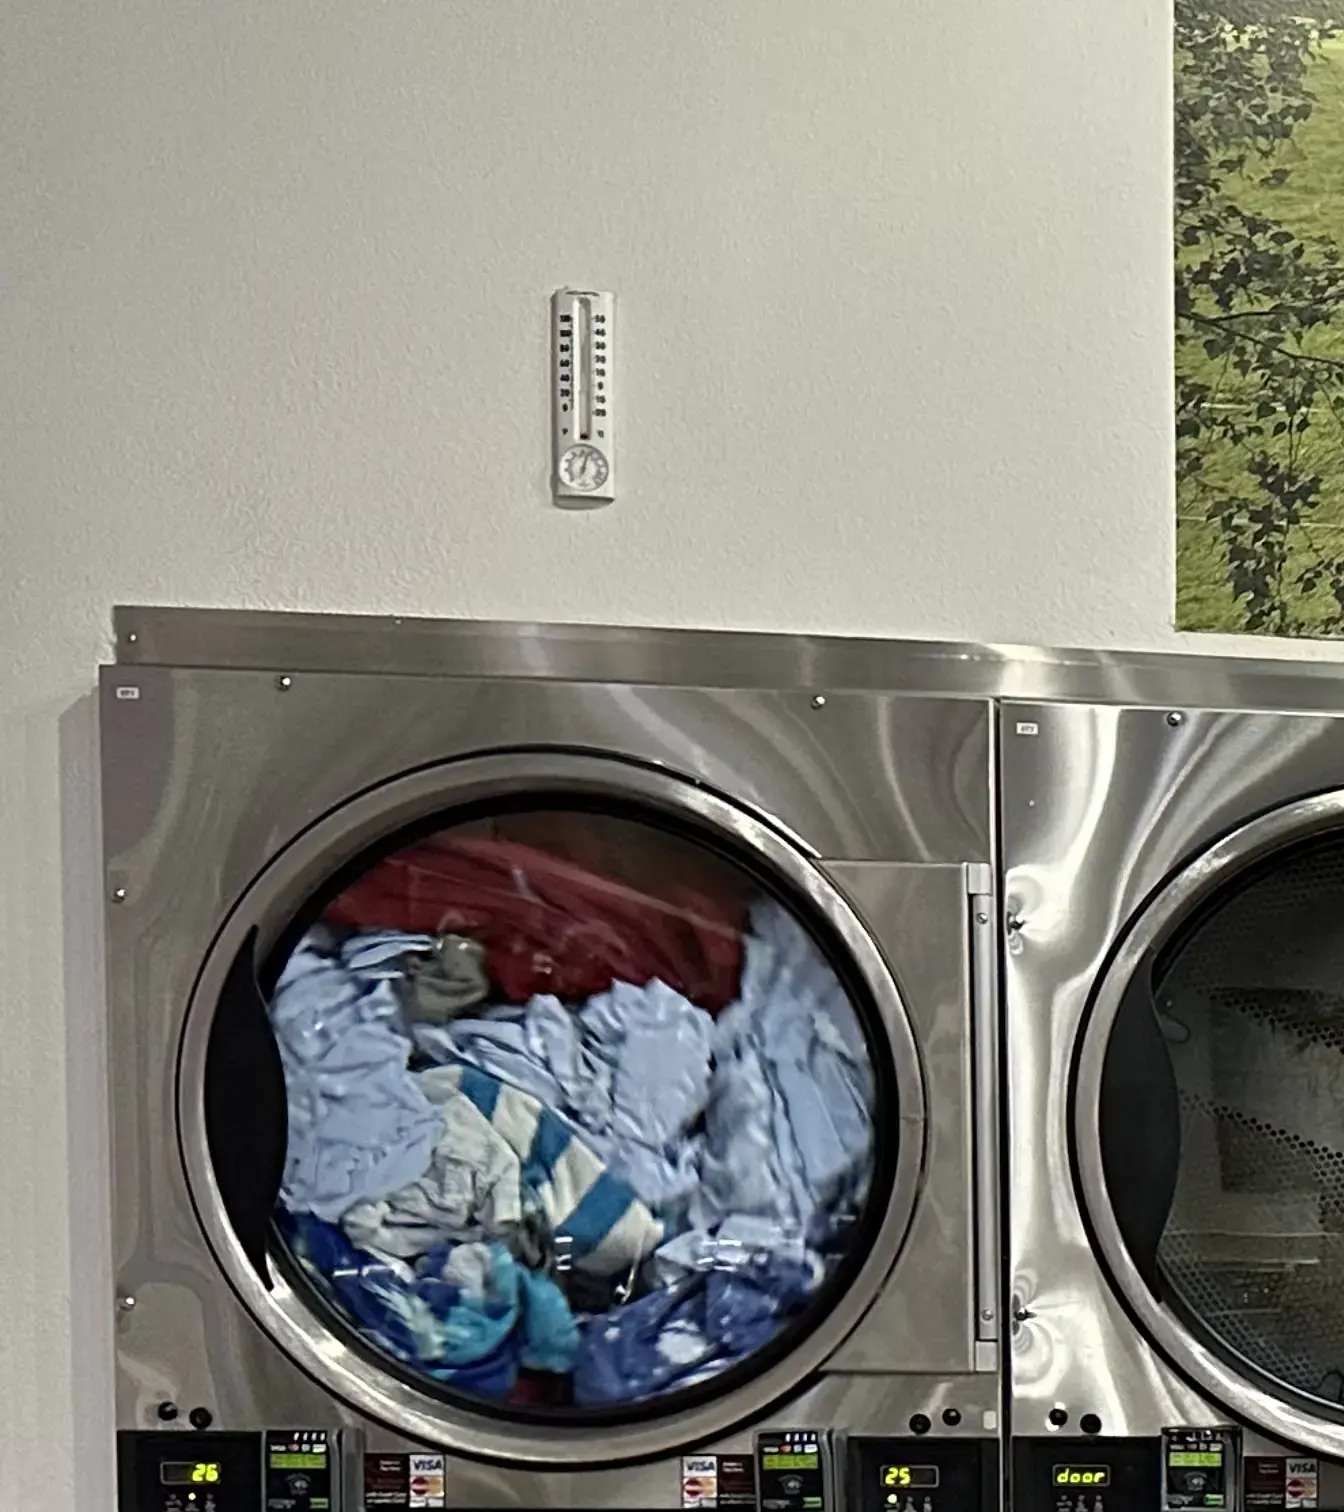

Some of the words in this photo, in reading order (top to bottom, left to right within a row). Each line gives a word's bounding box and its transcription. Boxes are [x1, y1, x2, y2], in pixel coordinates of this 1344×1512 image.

[413, 1459, 443, 1471] VISA
[686, 1461, 716, 1473] VISA
[1289, 1463, 1316, 1473] VISA
[192, 1463, 219, 1483] 26
[885, 1467, 912, 1484] 25
[1056, 1468, 1105, 1484] door
